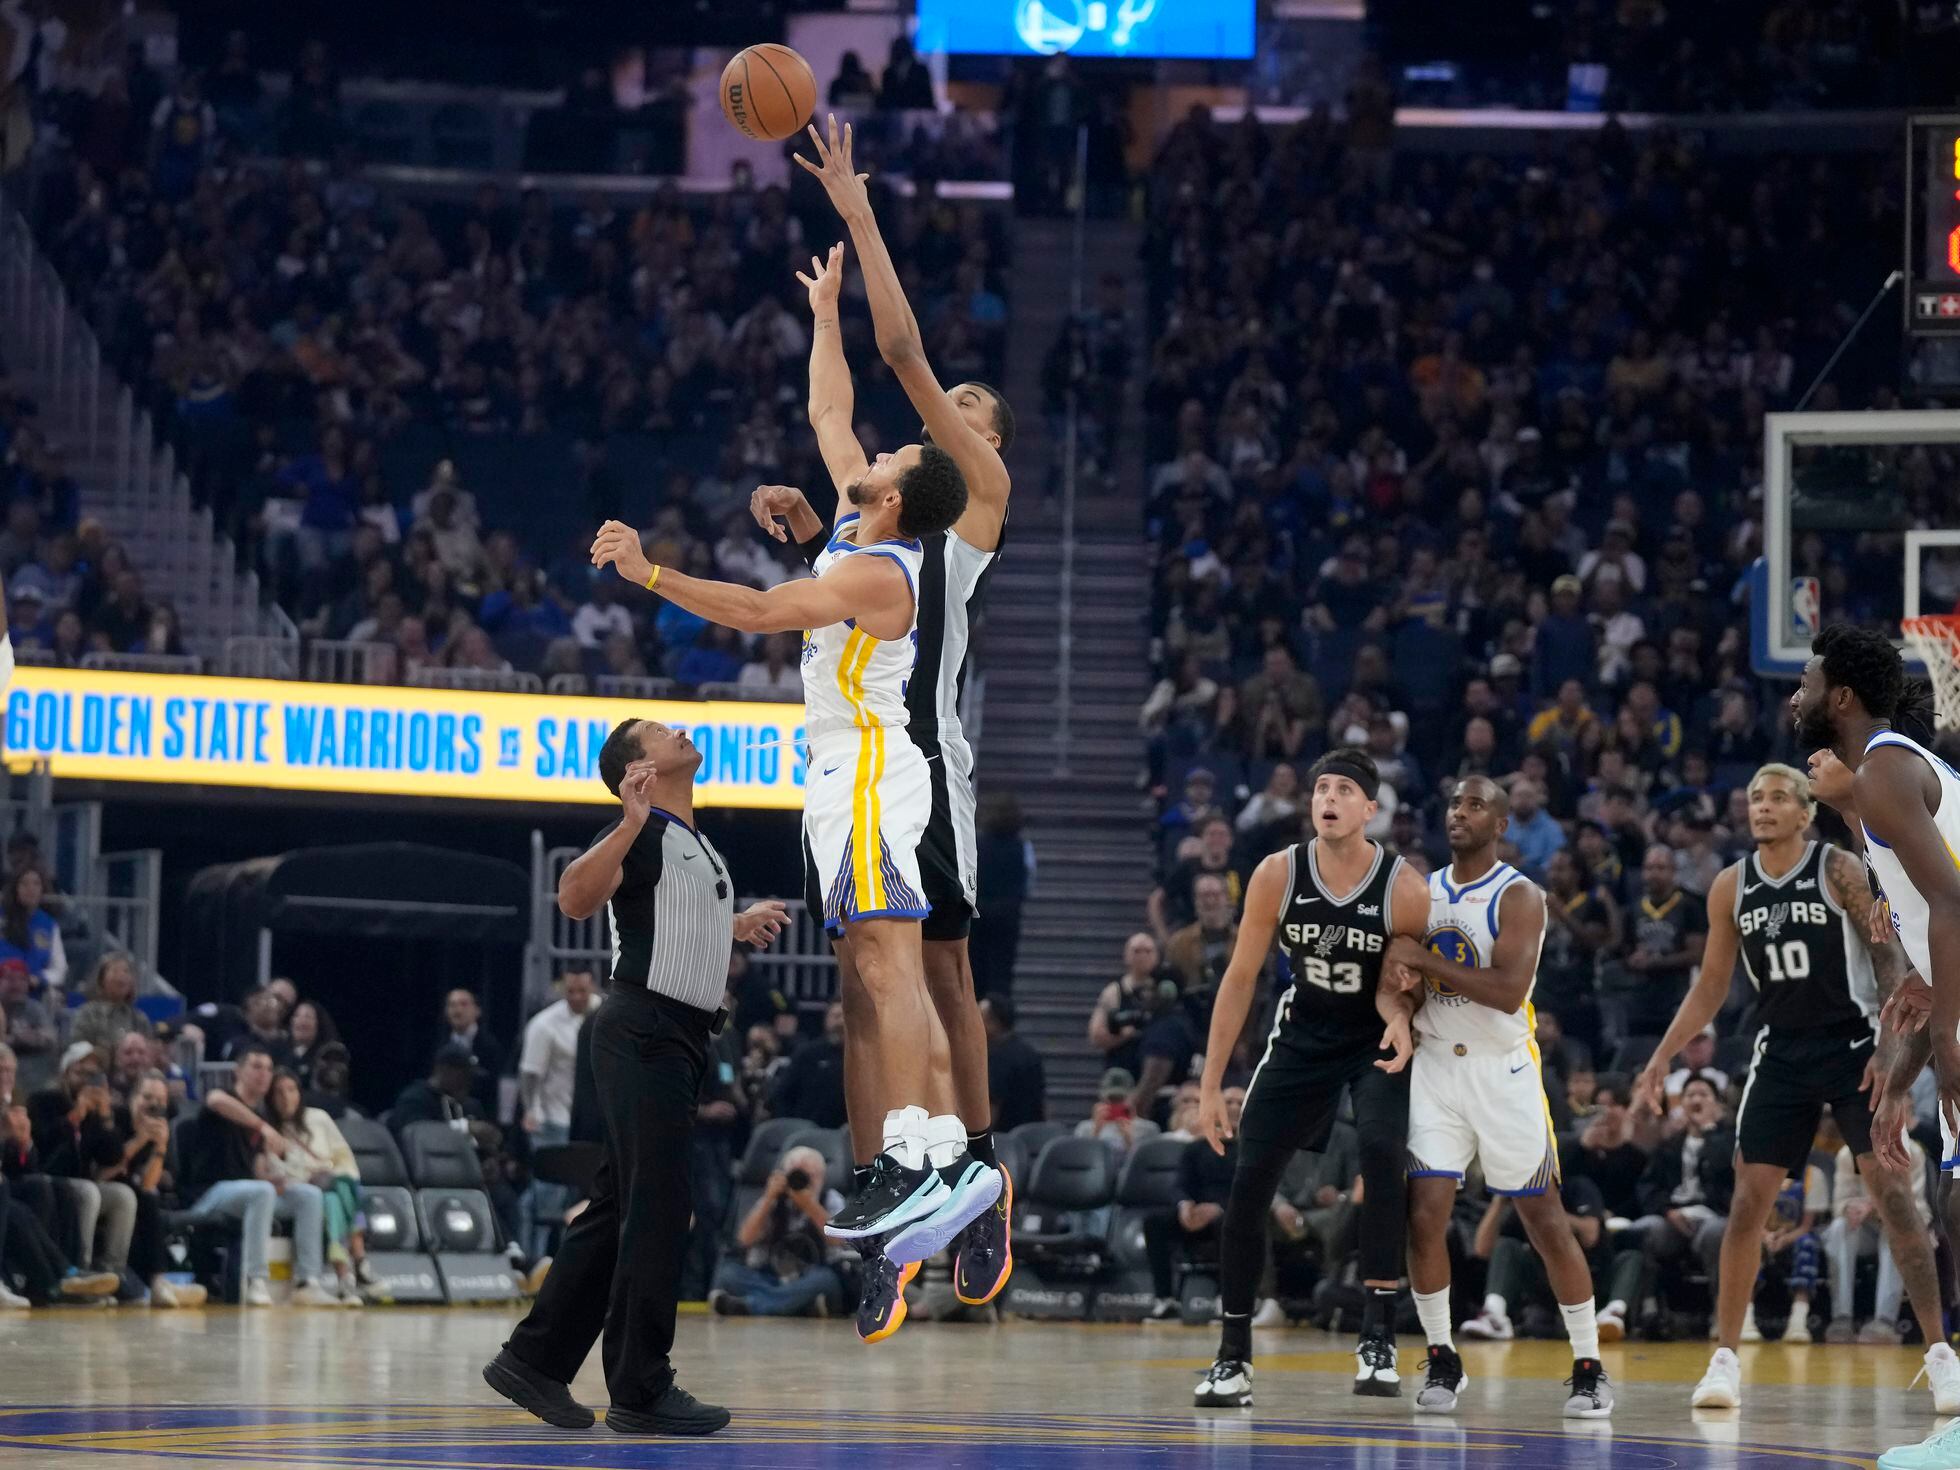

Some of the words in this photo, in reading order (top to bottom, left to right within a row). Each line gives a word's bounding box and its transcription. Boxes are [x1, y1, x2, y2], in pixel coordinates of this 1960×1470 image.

[7, 690, 152, 757] GOLDEN
[163, 698, 271, 763] STATE
[284, 705, 482, 774] WARRIORS
[535, 718, 610, 780] SAN
[691, 722, 780, 786] ONIO
[1739, 901, 1828, 938] SPURS
[1285, 923, 1384, 956] SPURS
[1455, 942, 1467, 963] 3
[1303, 955, 1363, 993] 23
[1765, 940, 1810, 981] 10
